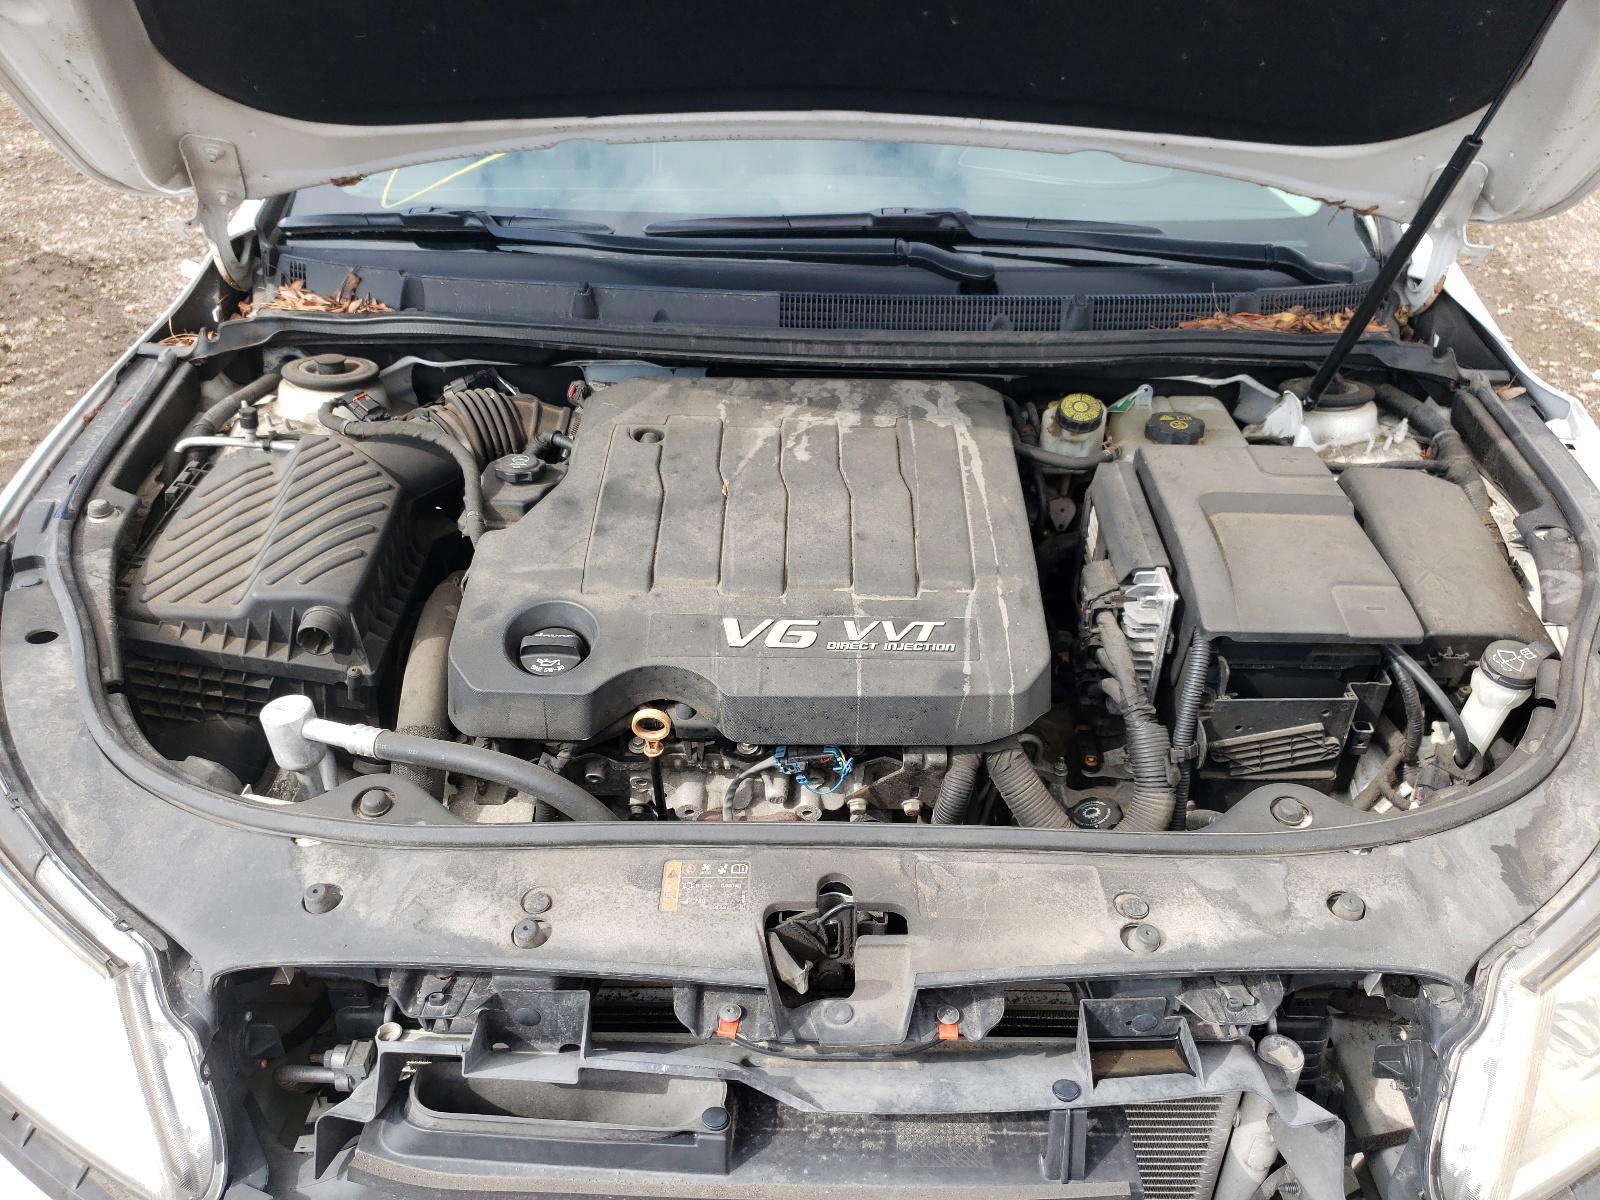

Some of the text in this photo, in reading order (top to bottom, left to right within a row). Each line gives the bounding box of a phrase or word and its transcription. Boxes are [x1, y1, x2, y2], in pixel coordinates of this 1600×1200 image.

[722, 618, 946, 649] V6 VVT
[826, 641, 956, 652] DIRECT INJECTION
